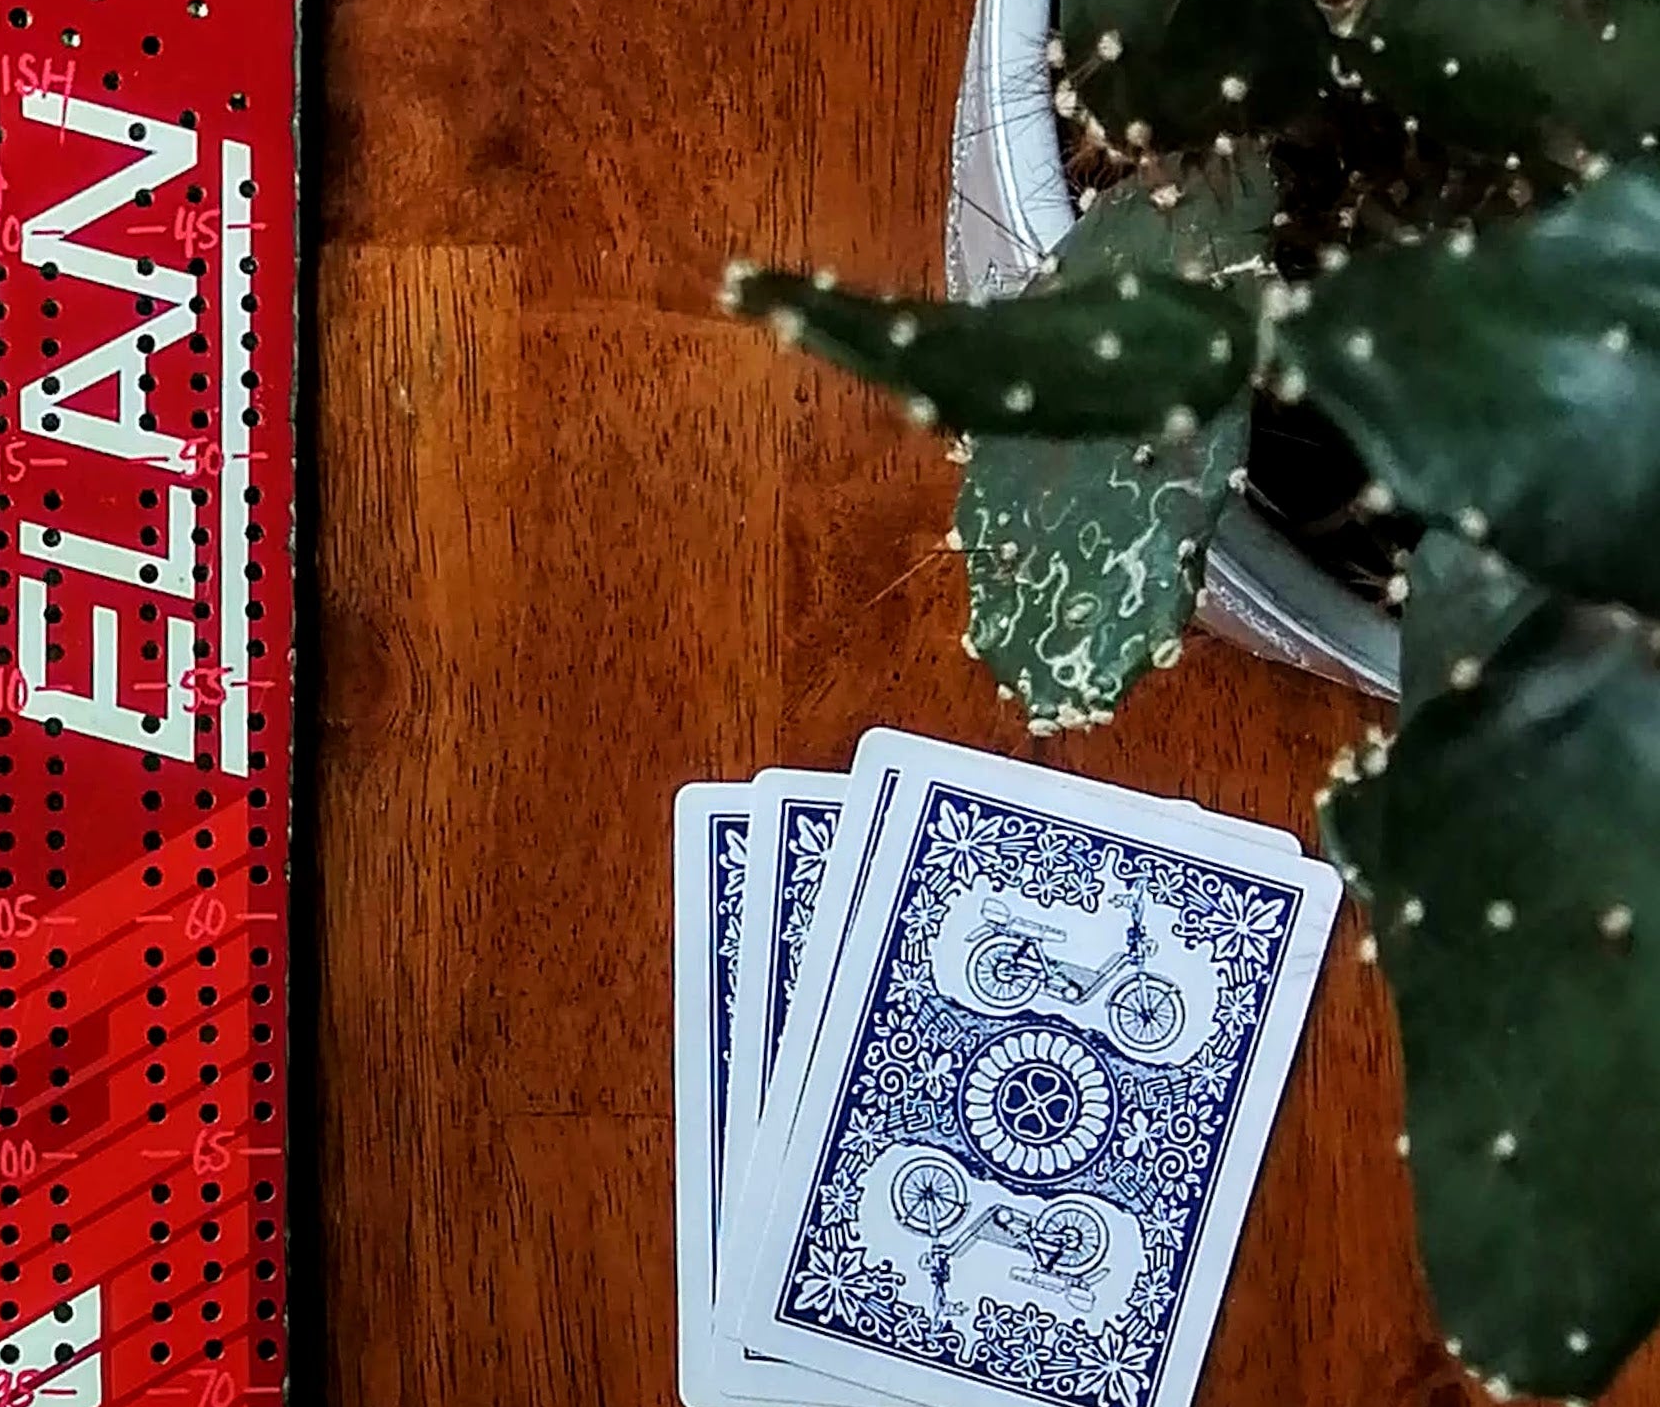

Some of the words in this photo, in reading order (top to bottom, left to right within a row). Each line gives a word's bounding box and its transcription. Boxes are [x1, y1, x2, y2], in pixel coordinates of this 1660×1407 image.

[173, 210, 219, 260] 45
[19, 89, 198, 763] ELAN
[184, 897, 226, 941] 60
[192, 1130, 235, 1175] 65
